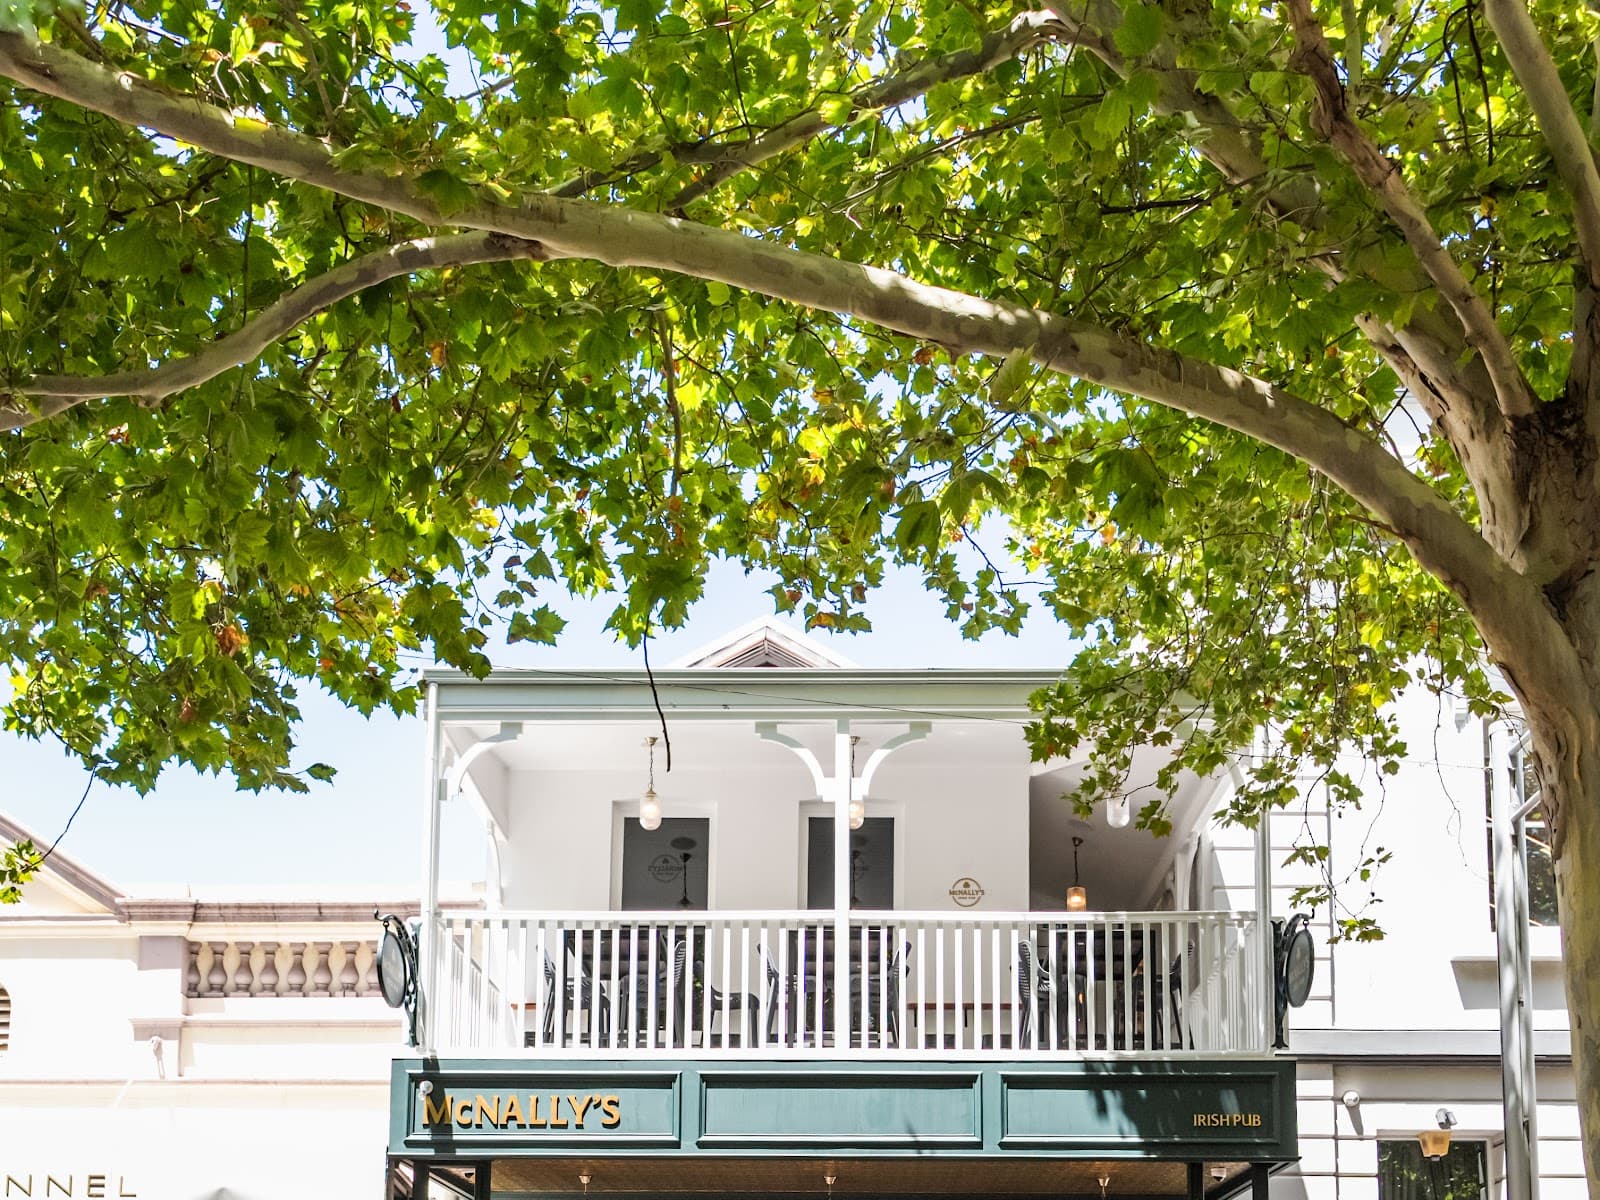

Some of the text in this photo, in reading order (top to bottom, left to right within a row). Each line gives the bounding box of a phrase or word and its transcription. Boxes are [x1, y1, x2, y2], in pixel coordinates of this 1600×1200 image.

[422, 1094, 621, 1129] McNALLY'S
[1193, 1113, 1261, 1127] IRISH PUB
[6, 1174, 137, 1198] NNEL
